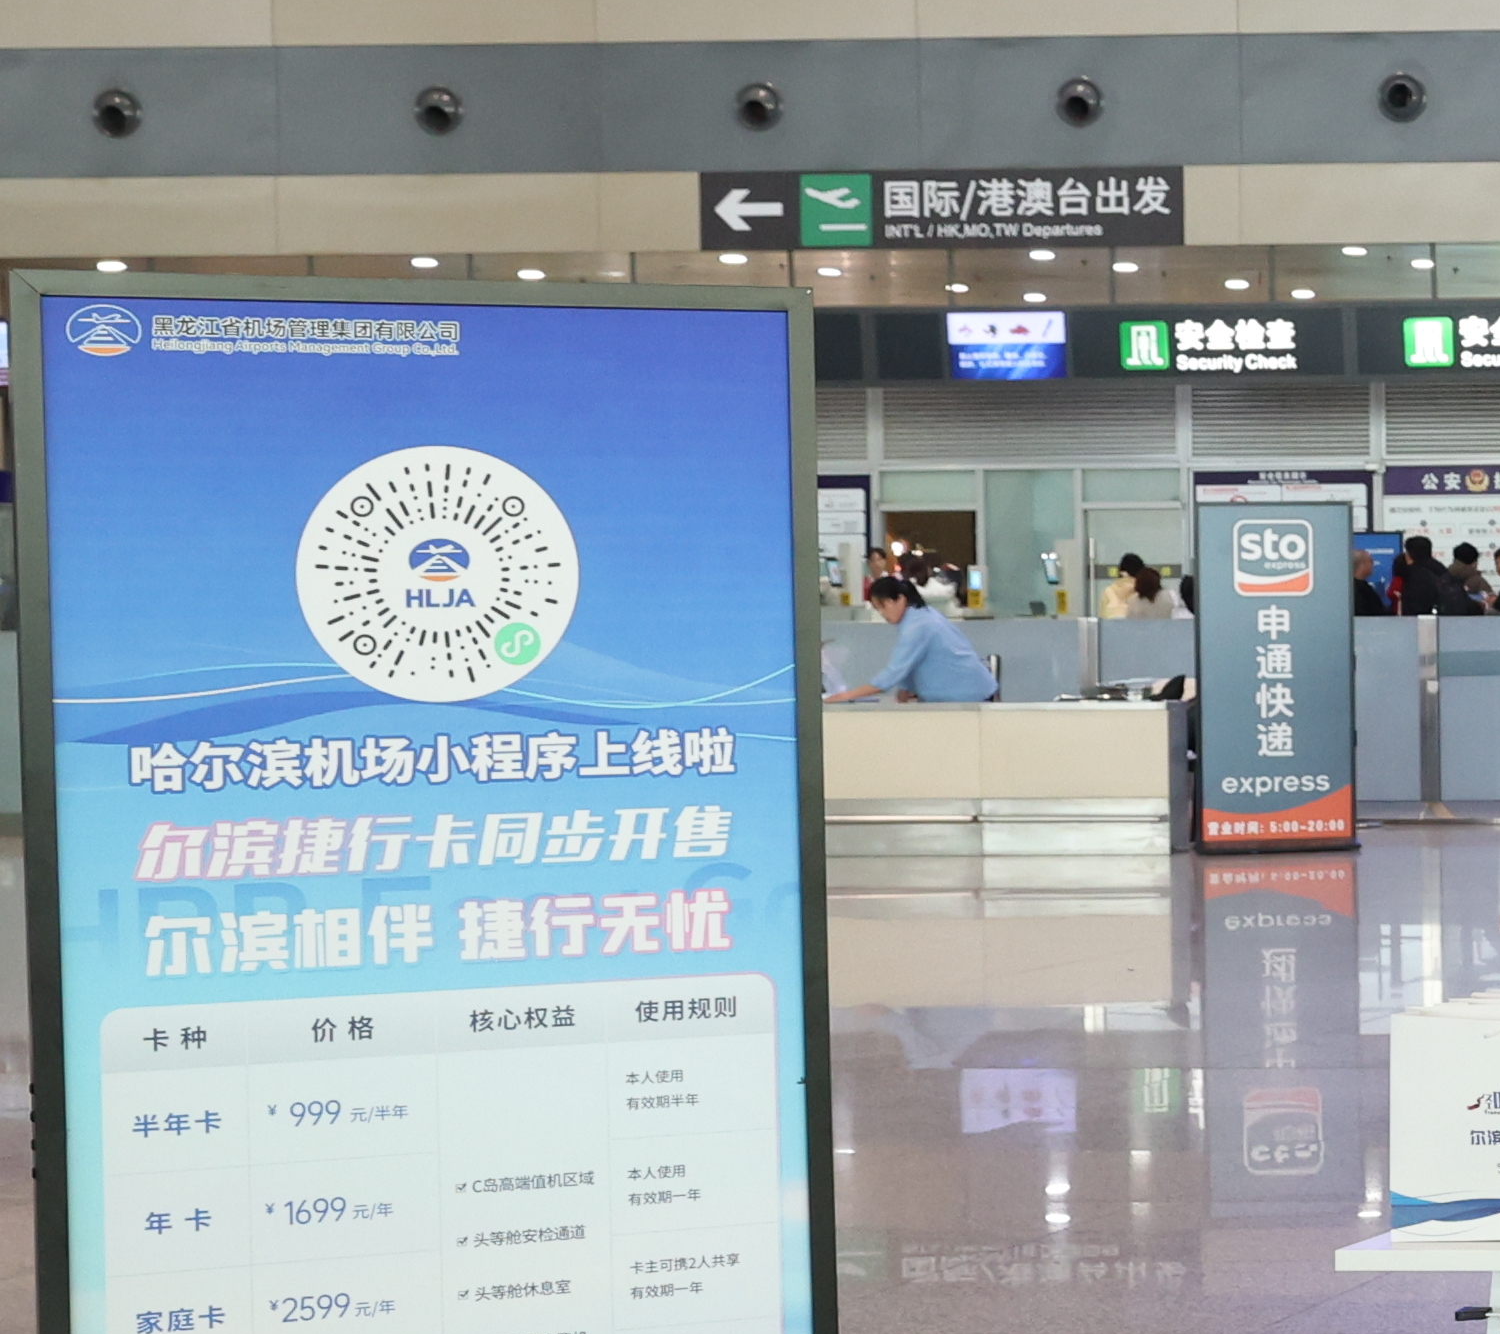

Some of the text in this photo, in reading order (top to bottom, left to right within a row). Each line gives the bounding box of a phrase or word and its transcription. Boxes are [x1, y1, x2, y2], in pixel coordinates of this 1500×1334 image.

[883, 176, 1172, 220] 国际/港澳台出发
[1022, 221, 1104, 239] Departures
[151, 313, 461, 343] 黑龙江省机场管理集团有限公司
[1174, 317, 1298, 351] 安全检查
[1175, 351, 1298, 374] Security Check
[1239, 527, 1304, 561] sto
[403, 587, 477, 611] HLJA
[1255, 604, 1295, 758] 申通快递
[129, 724, 738, 792] 哈尔滨机场小程序上线啦
[1220, 770, 1332, 798] express
[133, 805, 732, 883] 尔滨捷行卡同步开售
[144, 888, 733, 979] 尔滨相伴 捷行无忧
[468, 1003, 578, 1034] 核心权益
[633, 994, 739, 1024] 使用规则
[131, 1107, 224, 1139] 半年卡
[471, 1169, 596, 1195] C岛高端值机区域
[473, 1223, 588, 1251] 头等舱安检通道
[474, 1277, 573, 1304] 头等舱休息室
